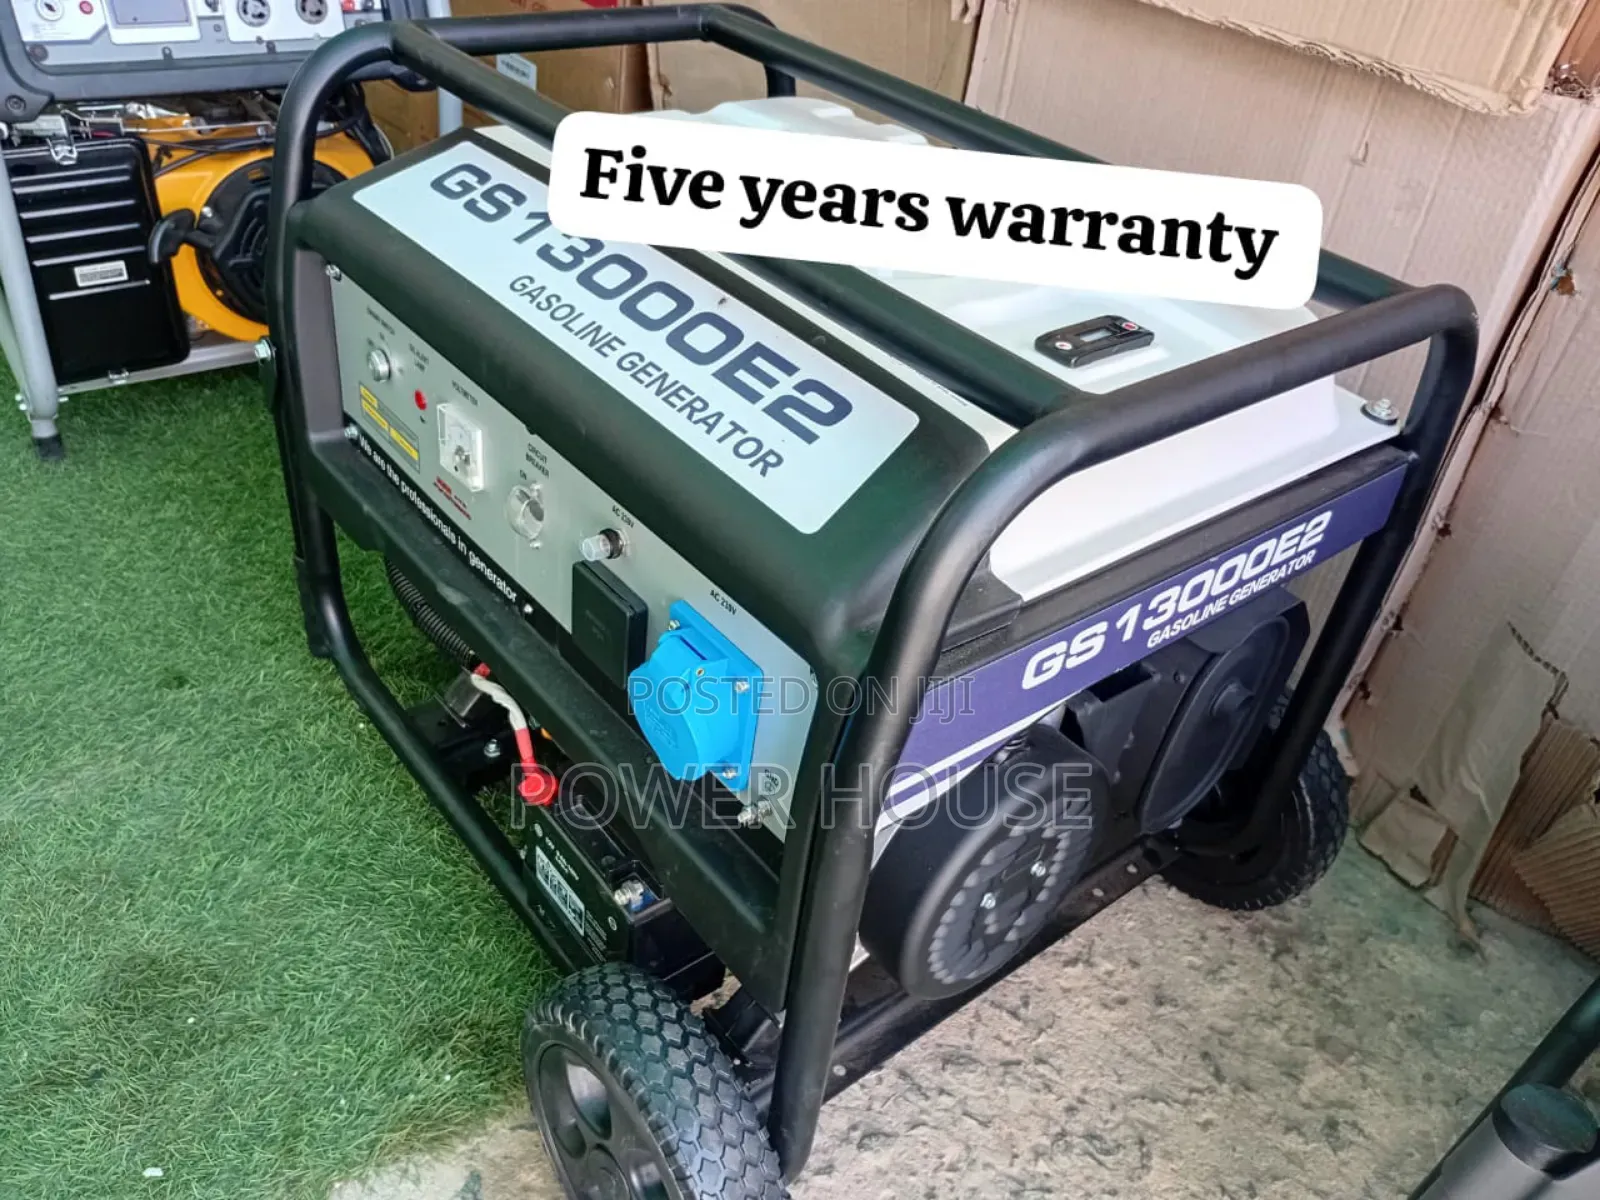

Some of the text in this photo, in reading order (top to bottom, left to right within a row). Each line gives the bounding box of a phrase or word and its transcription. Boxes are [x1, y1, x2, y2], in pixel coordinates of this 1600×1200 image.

[508, 275, 785, 477] GASOLINE GENERATOR
[458, 536, 467, 556] in
[468, 550, 517, 603] generator
[710, 589, 720, 602] AC
[1147, 549, 1317, 649] GASOLINE GENERATOR
